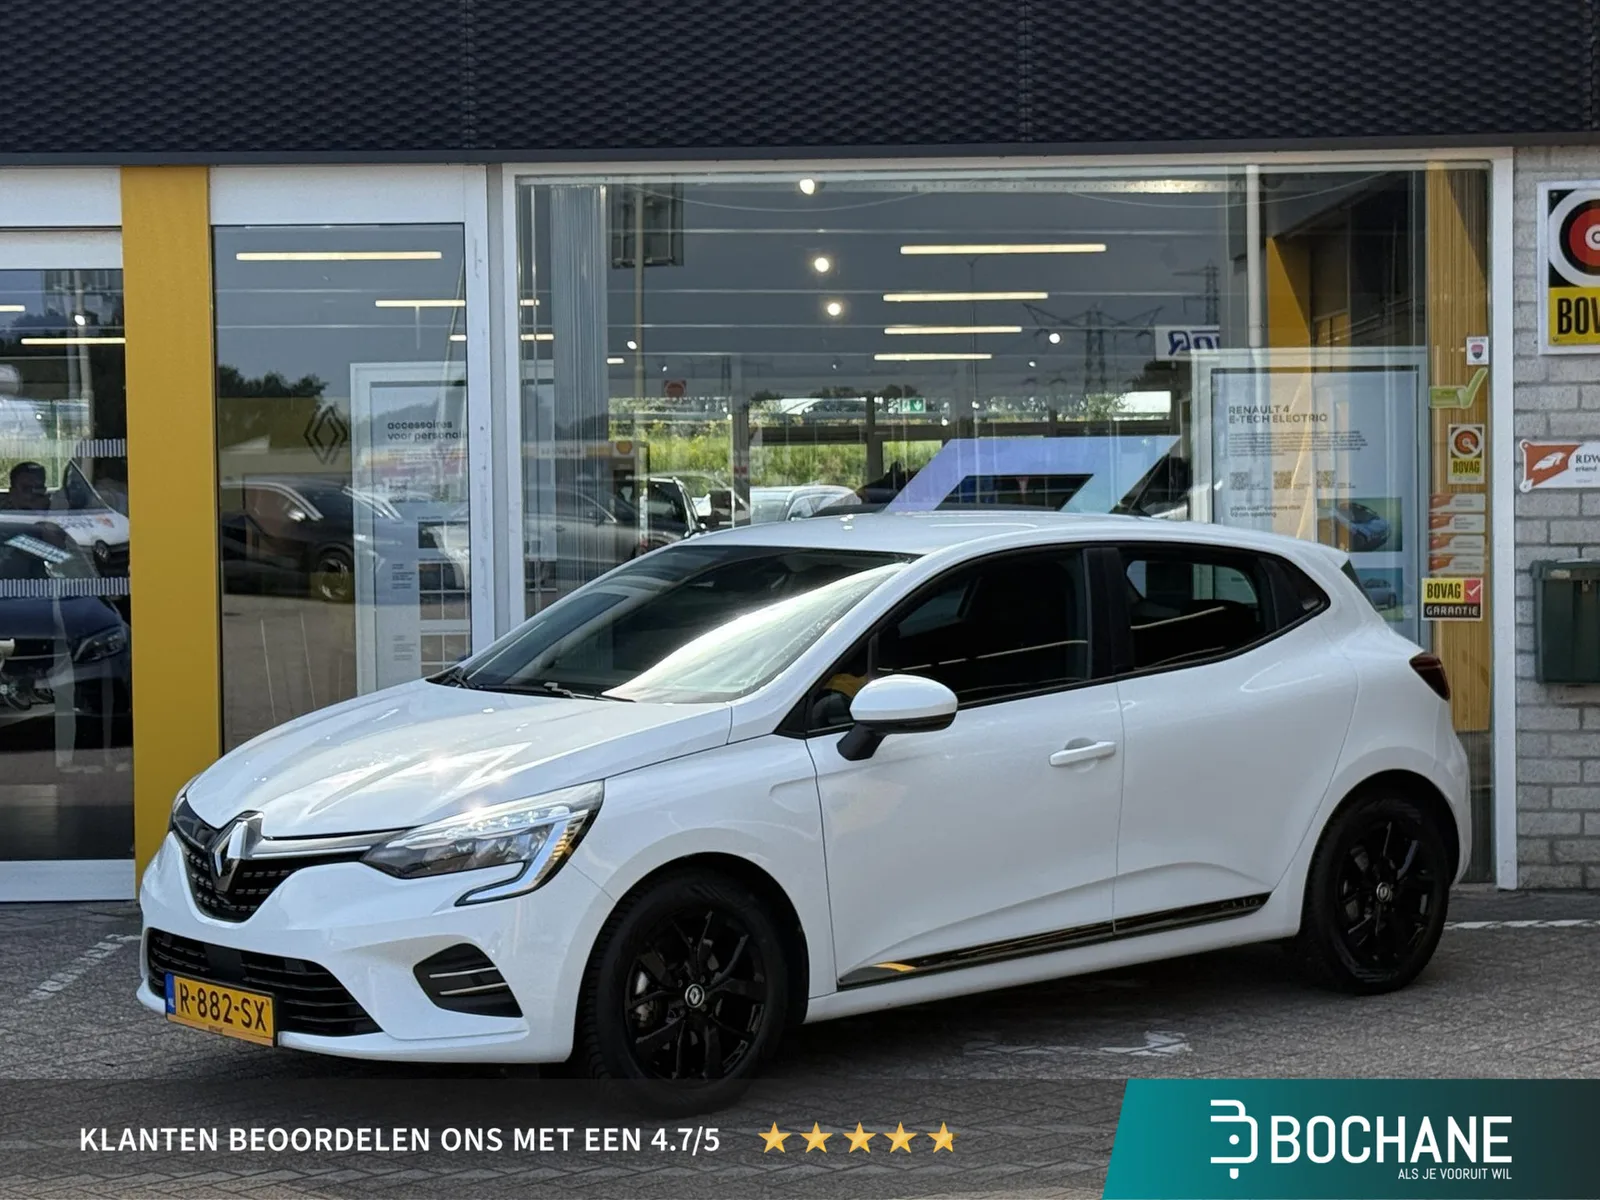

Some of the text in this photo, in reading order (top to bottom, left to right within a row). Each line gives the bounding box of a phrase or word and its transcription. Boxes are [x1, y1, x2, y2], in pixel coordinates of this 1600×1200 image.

[1229, 404, 1290, 415] RENAULT 4
[1229, 413, 1328, 424] E-TECH ELECTRIC
[387, 420, 453, 430] accessoires
[387, 431, 411, 440] voor
[1452, 459, 1480, 474] BOVAG
[1426, 582, 1462, 600] BOVAG
[1426, 604, 1479, 616] GARANTIE
[179, 982, 267, 1032] R-882-SX
